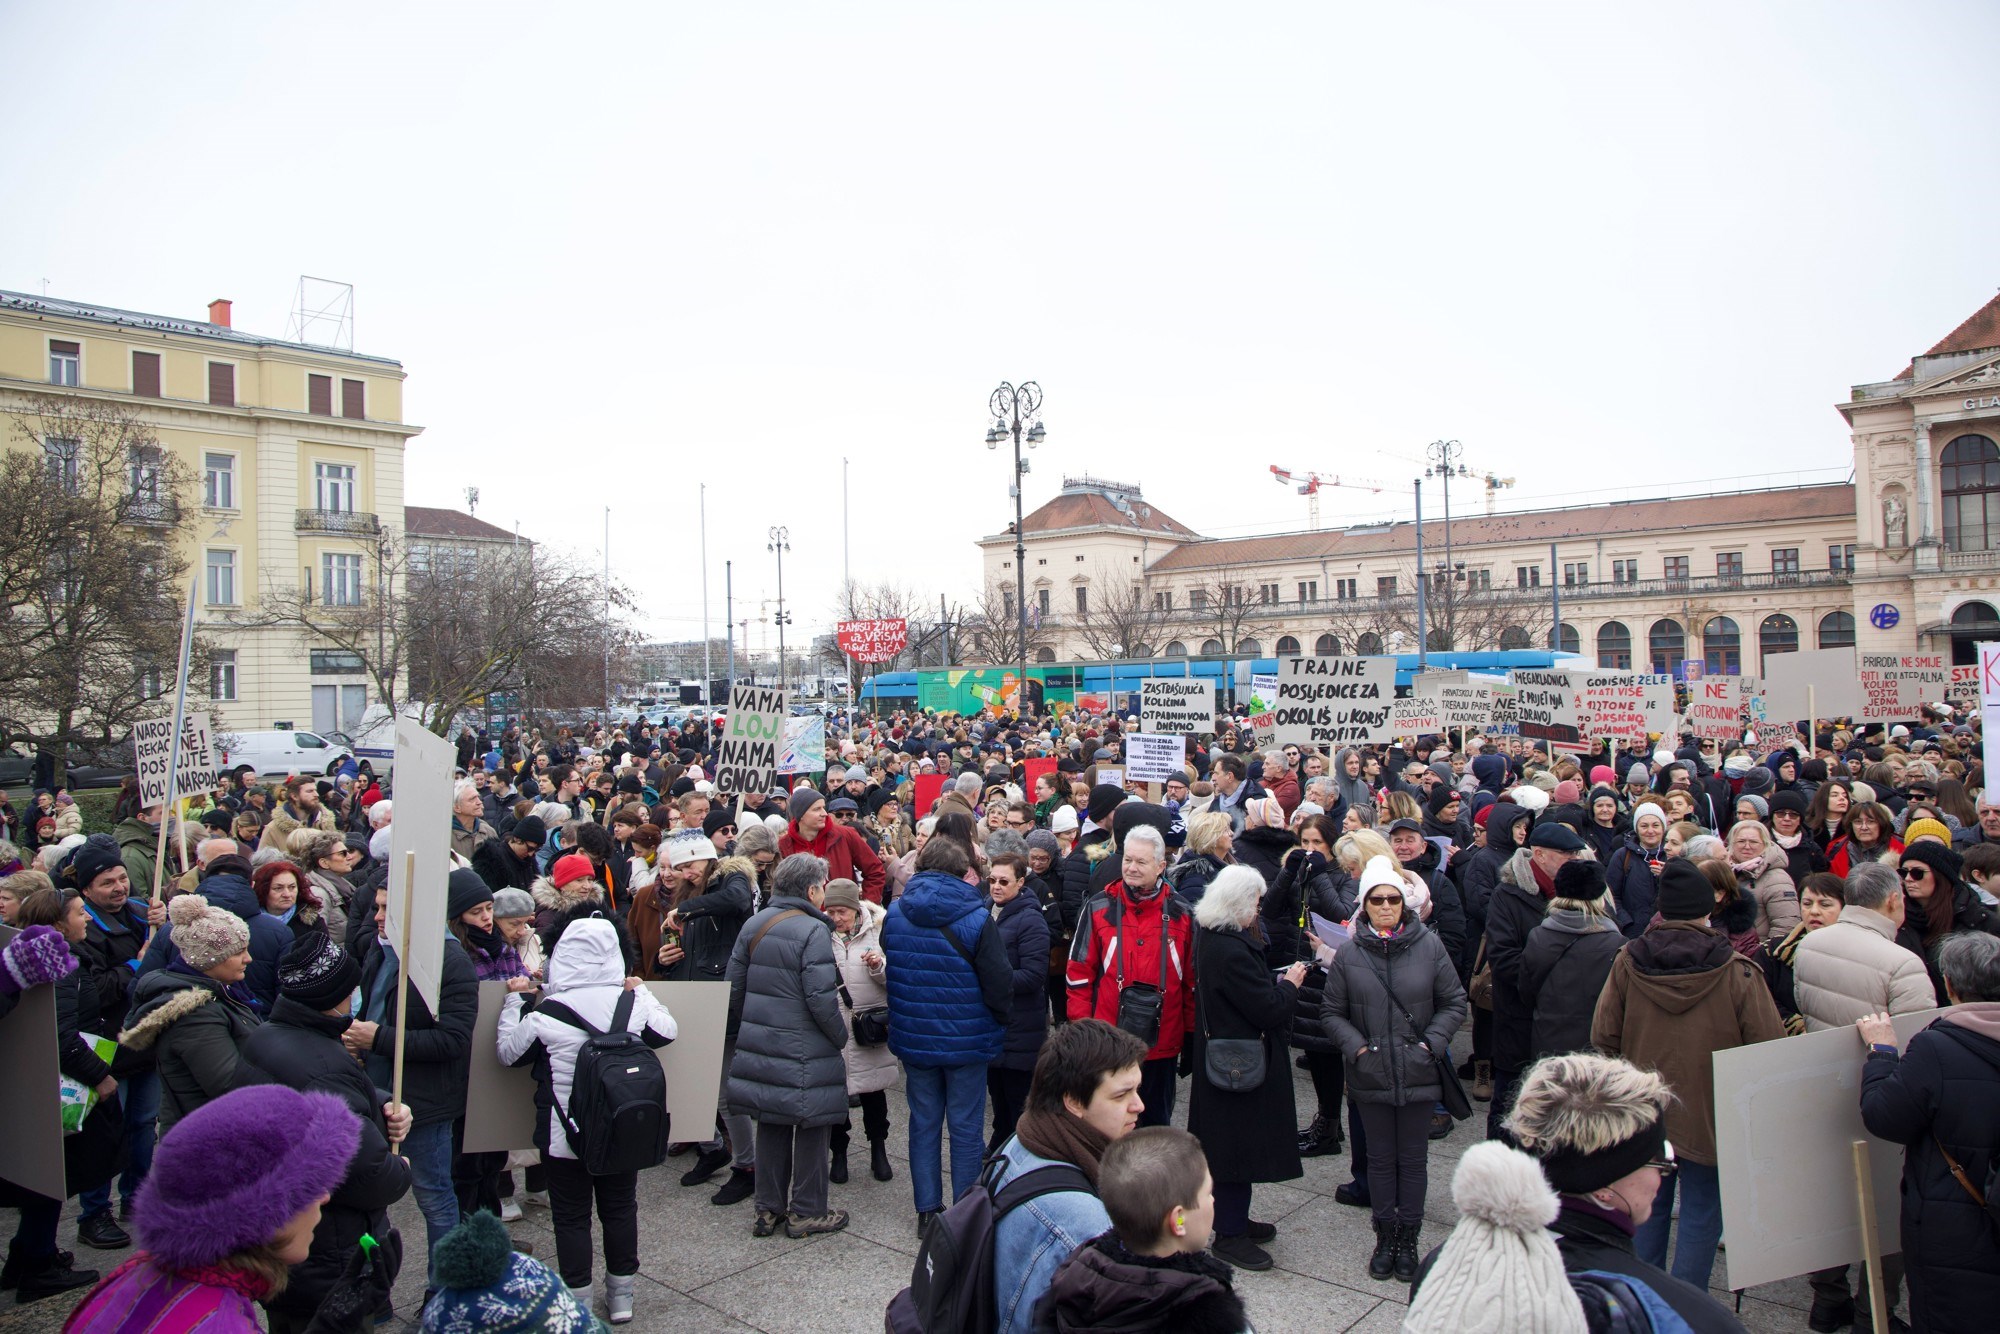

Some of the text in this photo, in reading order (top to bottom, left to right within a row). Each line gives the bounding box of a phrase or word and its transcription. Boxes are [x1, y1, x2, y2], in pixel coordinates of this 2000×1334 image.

[1290, 659, 1367, 676] TRAJNE
[1863, 656, 1942, 668] PRIRODA NE SMIJE
[1514, 672, 1570, 688] MEGAKLAONICA
[1587, 674, 1668, 687] GODIŠNJE ŽELE
[1863, 680, 1897, 690] KOLIKO
[1143, 682, 1204, 696] ZASTRAŠUJUĆA
[1359, 682, 1380, 699] ZA
[1442, 688, 1473, 698] HRVATSKOJ
[1476, 689, 1488, 698] NE
[1705, 683, 1728, 699] NE
[1868, 688, 1898, 698] KOŠTA
[733, 687, 783, 714] VAMA
[1144, 696, 1186, 707] KOLIČINA
[1494, 697, 1516, 710] NE
[1517, 690, 1525, 704] JE
[1868, 698, 1898, 707] JEDNA
[1442, 700, 1491, 711] TREBAJU FARME
[1602, 700, 1635, 711] TONE
[1863, 705, 1919, 719] ŽUPANIJA?
[1142, 710, 1210, 721] OTPADNIH VODA
[1275, 705, 1332, 726] OKOLIŠ
[1350, 706, 1392, 728] KORIST
[1451, 712, 1486, 723] KLAONICE
[1518, 707, 1551, 725] ZDRAVOJ
[1693, 704, 1739, 722] OTROVNIM
[1156, 721, 1194, 731] DNEVNO
[1692, 724, 1740, 740] ULAGANIMA
[1311, 727, 1369, 742] PROFITA
[721, 740, 775, 768] NAMA
[176, 769, 219, 795] NARODA
[717, 767, 778, 794] GNOJ!
